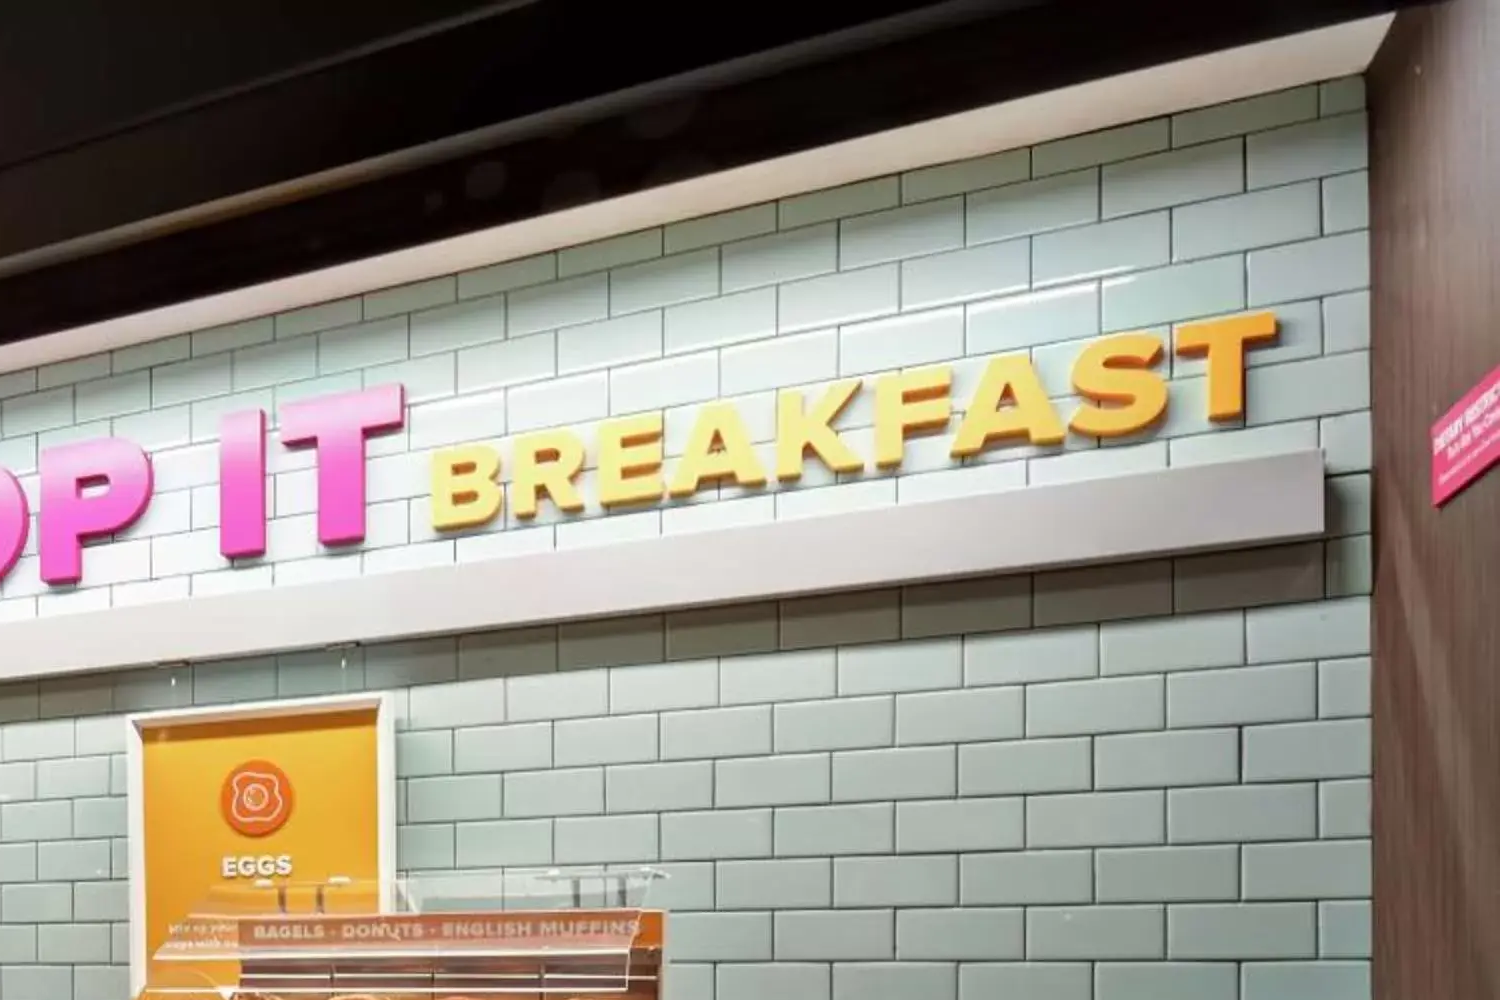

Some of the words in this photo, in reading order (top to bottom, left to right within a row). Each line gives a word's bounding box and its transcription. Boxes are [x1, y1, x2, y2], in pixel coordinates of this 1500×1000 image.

[216, 382, 404, 560] IT
[429, 312, 1278, 532] BREAKFAST
[221, 854, 293, 878] EGGS
[253, 924, 325, 940] BAGELS
[342, 922, 424, 941] DONUTS
[442, 920, 531, 938] ENGLISH
[540, 918, 640, 936] MUFFINS
